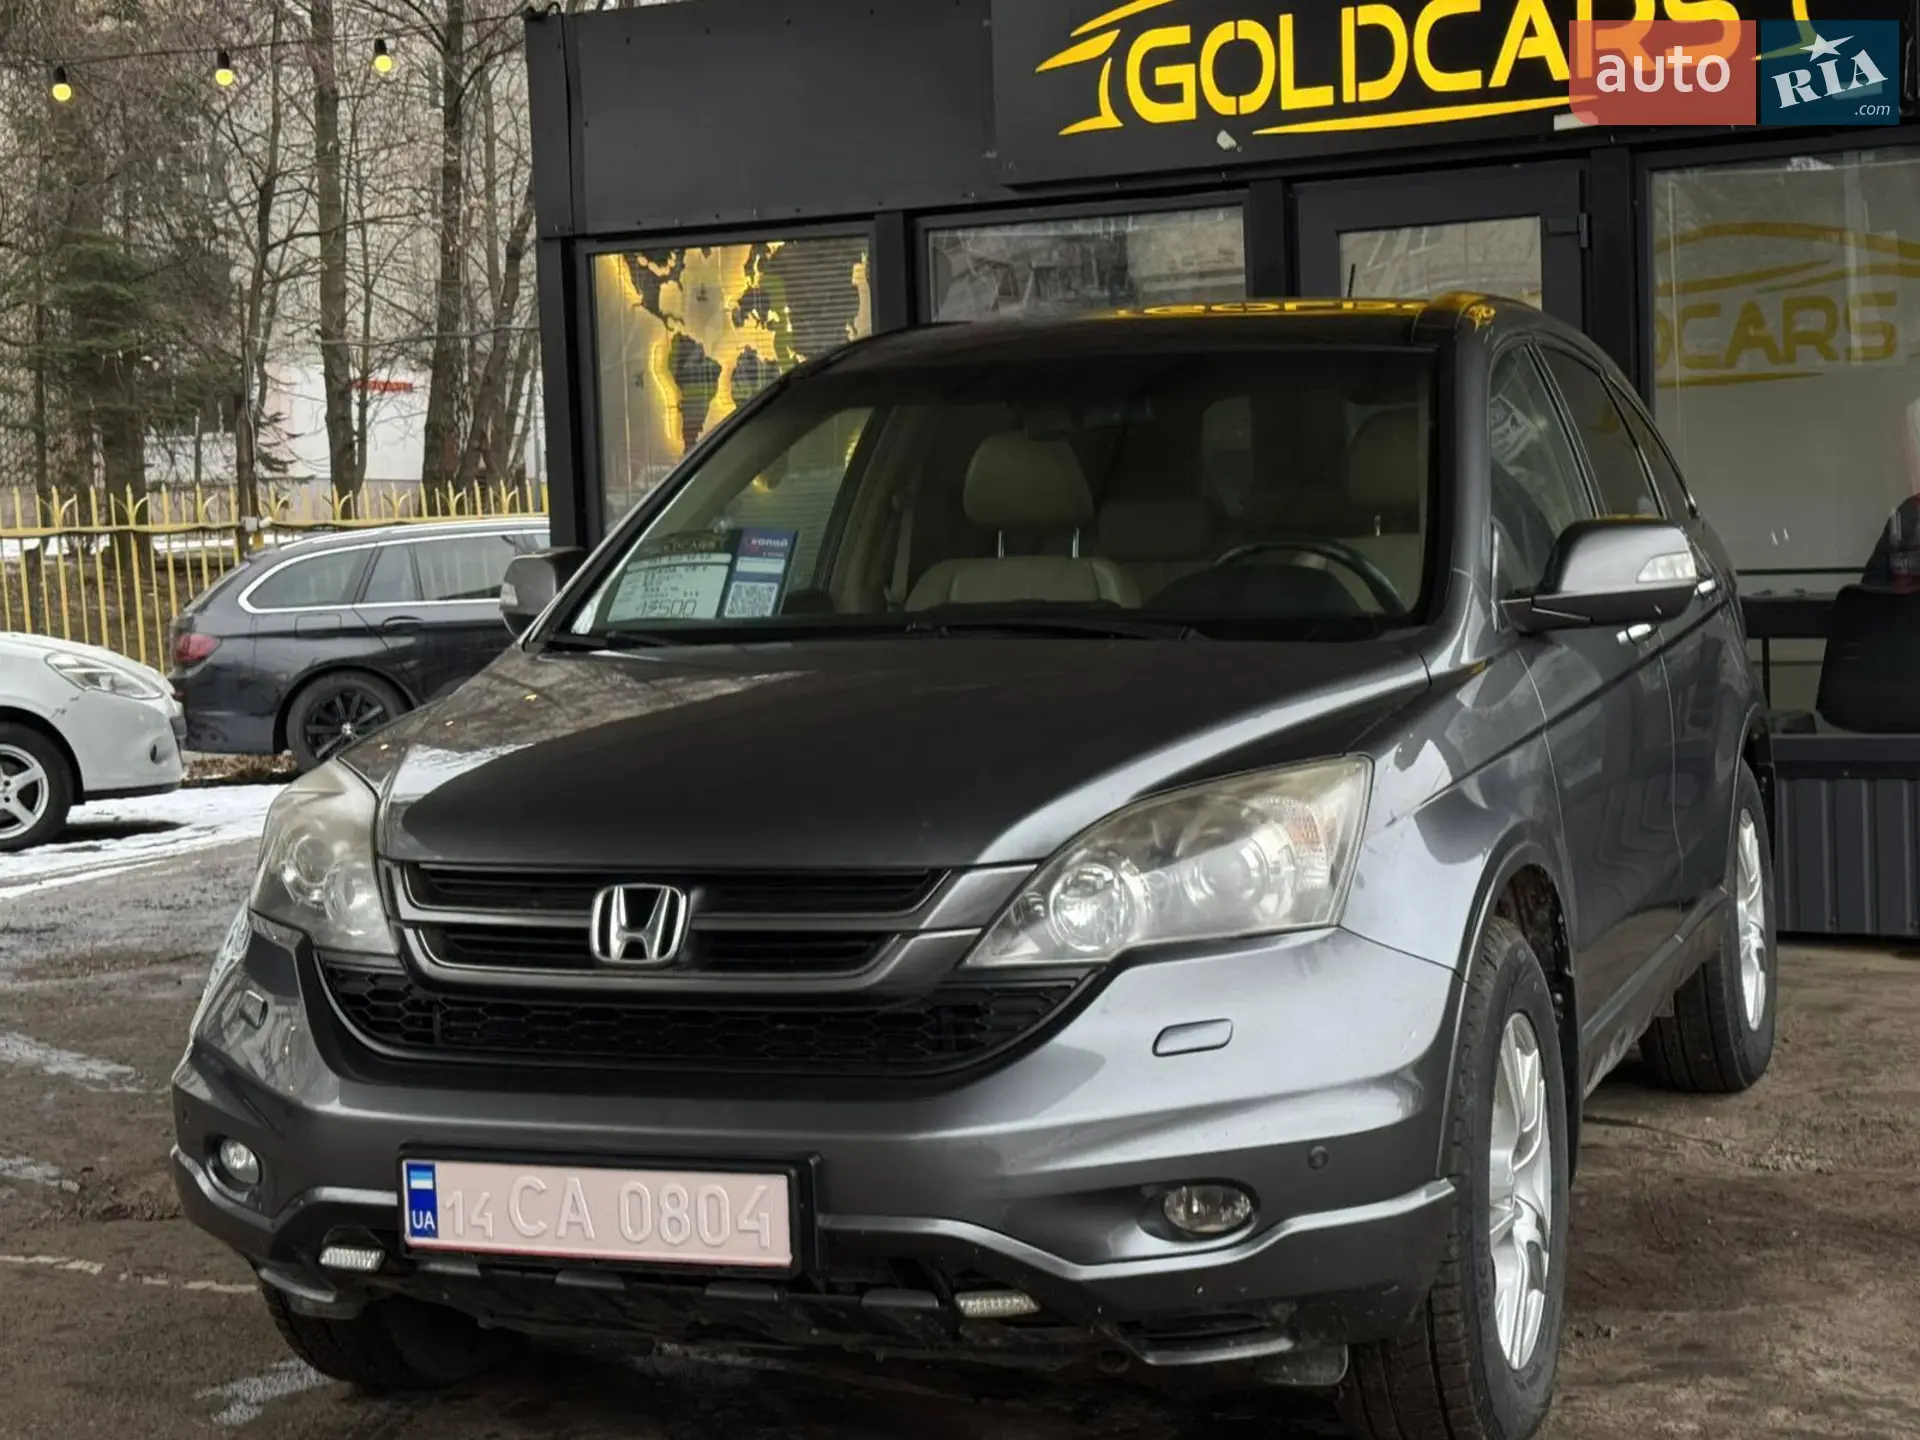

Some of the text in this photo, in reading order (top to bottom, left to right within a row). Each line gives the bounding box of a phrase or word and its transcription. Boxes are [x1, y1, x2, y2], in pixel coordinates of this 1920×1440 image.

[1126, 0, 1742, 123] GOLDCARS
[412, 1210, 436, 1231] UA
[443, 1174, 772, 1249] 14 CA 0804
